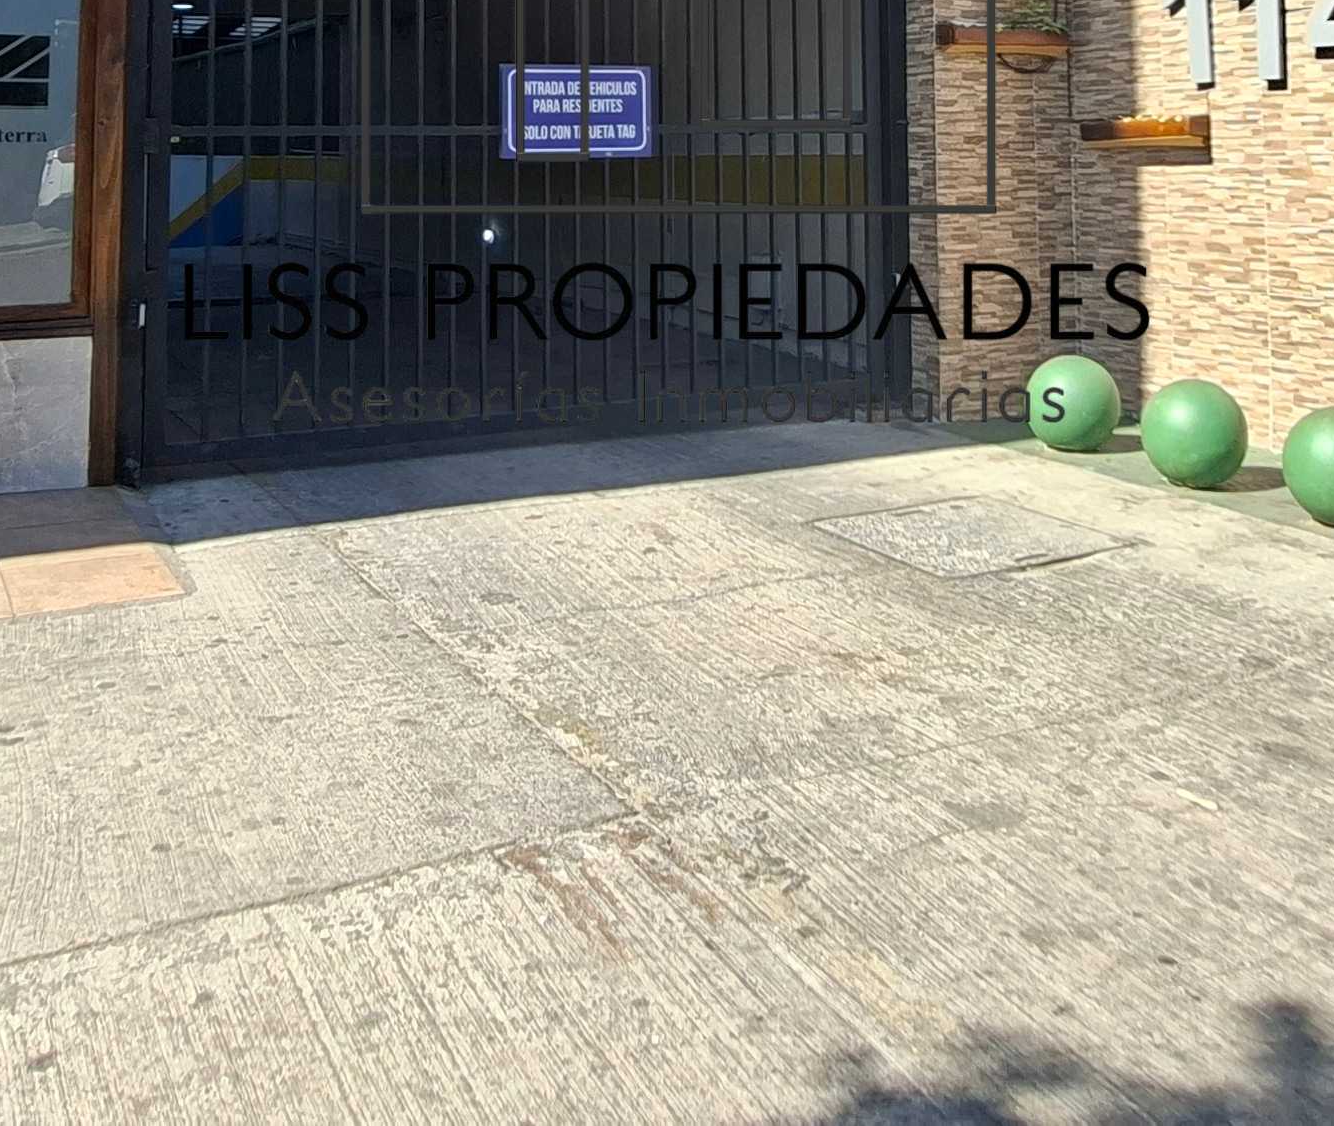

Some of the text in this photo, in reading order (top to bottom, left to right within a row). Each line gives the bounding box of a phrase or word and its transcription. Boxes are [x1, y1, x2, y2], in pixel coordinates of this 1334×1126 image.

[521, 80, 637, 96] NTRADA DE EHICULOS
[533, 99, 623, 114] PARA RESENTES
[523, 124, 636, 140] SOLO CON TJETA TAG
